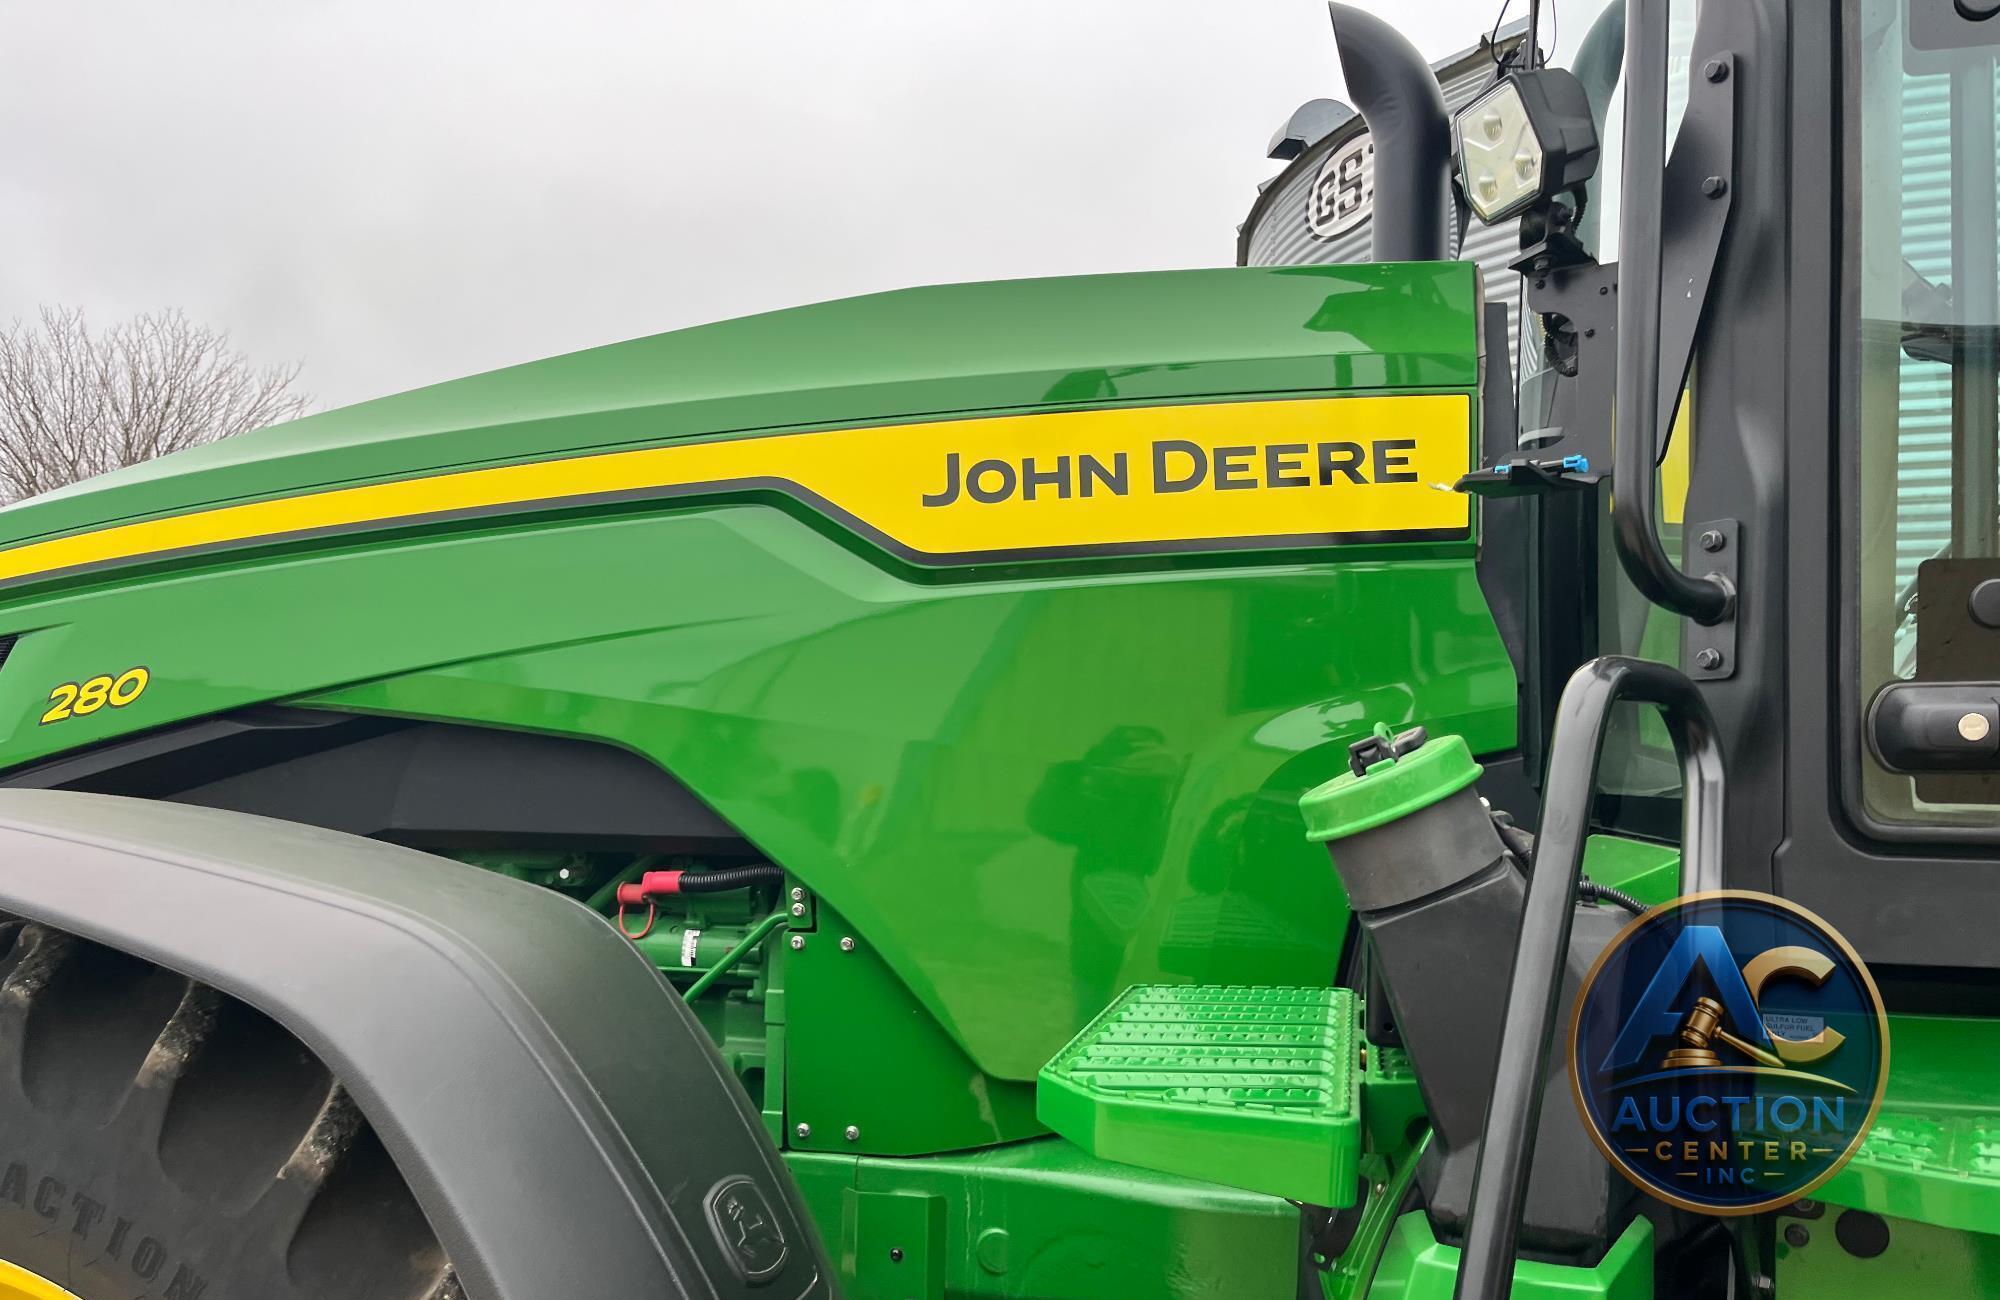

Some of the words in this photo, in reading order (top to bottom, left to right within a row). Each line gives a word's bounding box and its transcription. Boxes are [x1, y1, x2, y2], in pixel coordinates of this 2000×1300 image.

[1316, 144, 1374, 227] GS
[922, 452, 1129, 507] JOHN
[1152, 439, 1418, 494] DEERE
[39, 665, 151, 726] 280
[1765, 1015, 1790, 1023] ULTRA
[1792, 1016, 1809, 1024] LOW
[1796, 1024, 1814, 1032] FUEL
